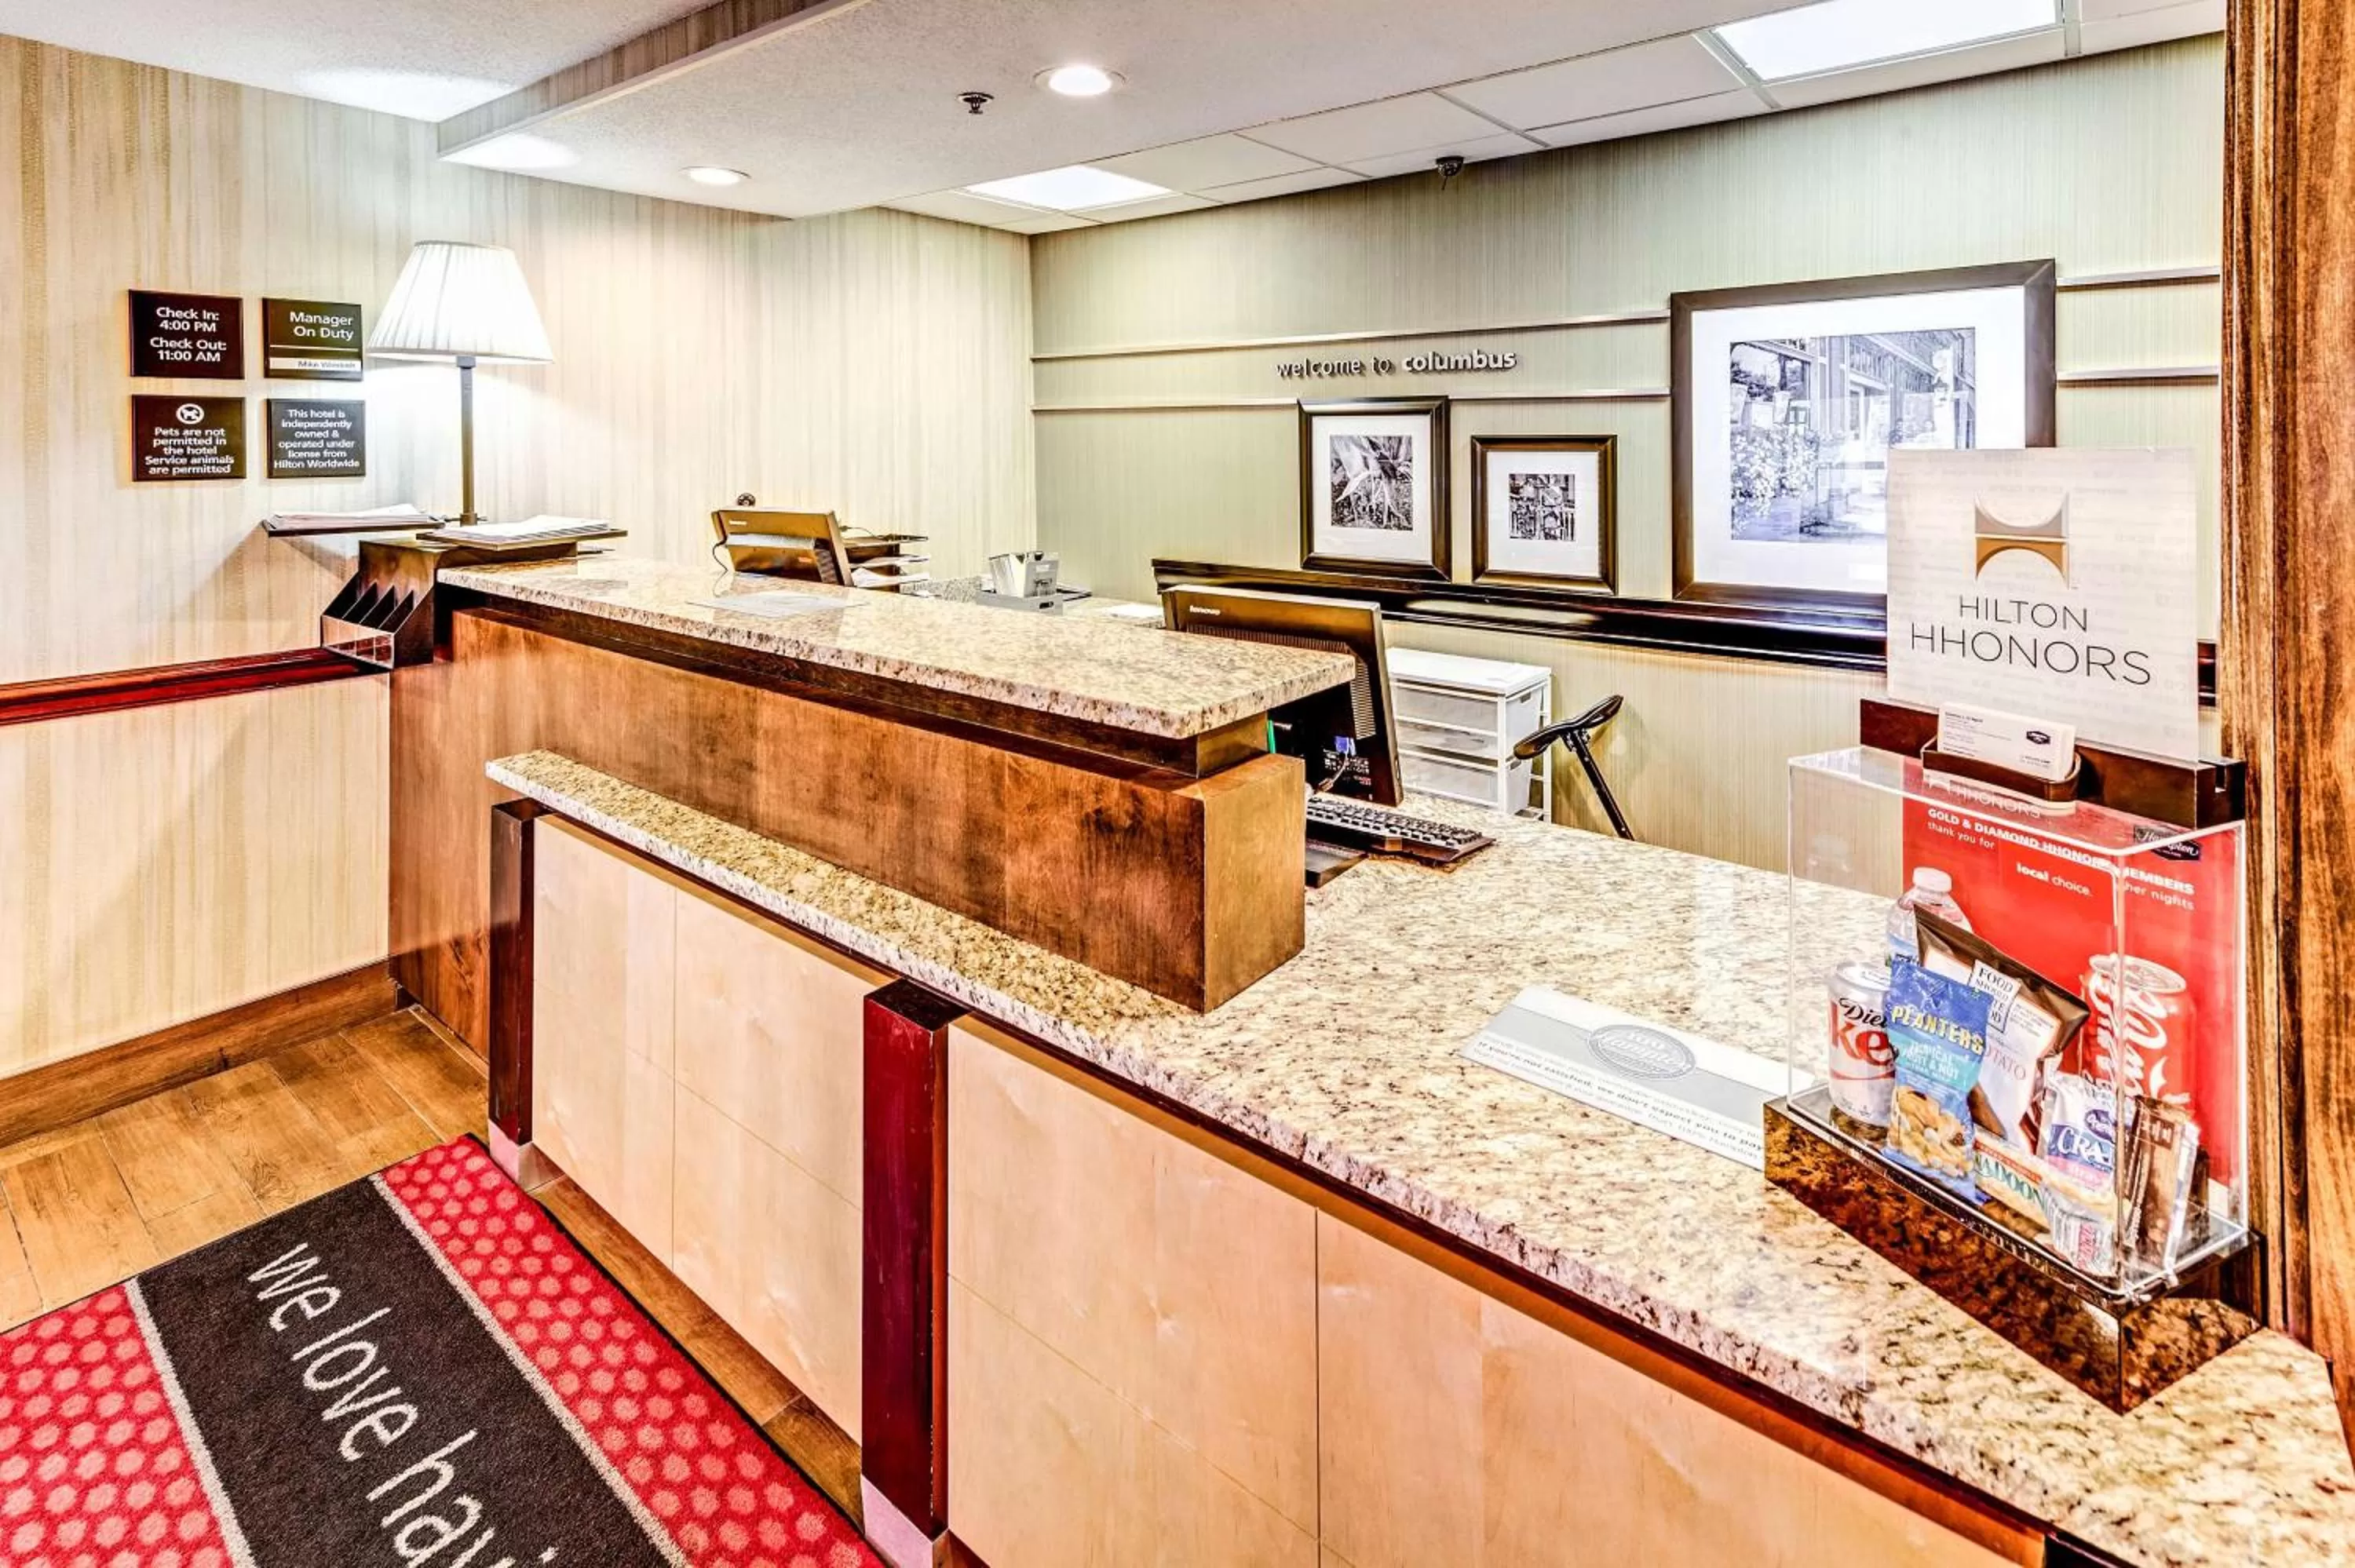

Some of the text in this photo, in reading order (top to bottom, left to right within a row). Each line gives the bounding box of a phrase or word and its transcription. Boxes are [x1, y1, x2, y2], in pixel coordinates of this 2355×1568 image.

[156, 307, 220, 321] Check In:
[289, 311, 353, 327] Manager
[159, 319, 217, 333] 4:00 PM
[294, 326, 354, 341] On Duty
[150, 337, 227, 351] Check Out:
[158, 349, 221, 362] 11:00 AM
[1276, 348, 1517, 377] welcome to columbus
[288, 409, 345, 418] This hotel is
[155, 427, 180, 436] Pets
[205, 428, 225, 436] not
[282, 418, 352, 430] independently
[153, 436, 227, 448] permitted in
[279, 439, 355, 450] operated under
[163, 446, 217, 454] the hotel
[288, 448, 348, 458] license from
[145, 455, 235, 465] Service animals
[274, 458, 360, 469] Hilton Worldwide
[148, 465, 231, 476] are permitted
[1959, 594, 2088, 633] HILTON
[1911, 622, 2152, 686] HHONORS
[1928, 808, 1960, 826] GOLD
[1962, 819, 1972, 829] &
[1974, 822, 2040, 850] DIAMOND
[1928, 822, 1995, 850] thank you for
[2016, 862, 2050, 883] local
[2151, 890, 2195, 911] nights
[1979, 967, 2014, 994] FOOD
[1892, 1005, 1984, 1056] PLANTERS
[1937, 1059, 1960, 1078] NUT
[1616, 1092, 1648, 1108] don't
[1652, 1105, 1691, 1124] expect
[1696, 1122, 1719, 1136] you
[1723, 1132, 1736, 1141] to
[1739, 1139, 1762, 1151] pay
[247, 1242, 341, 1332] we
[290, 1307, 419, 1463] love
[366, 1427, 558, 1568] hav
